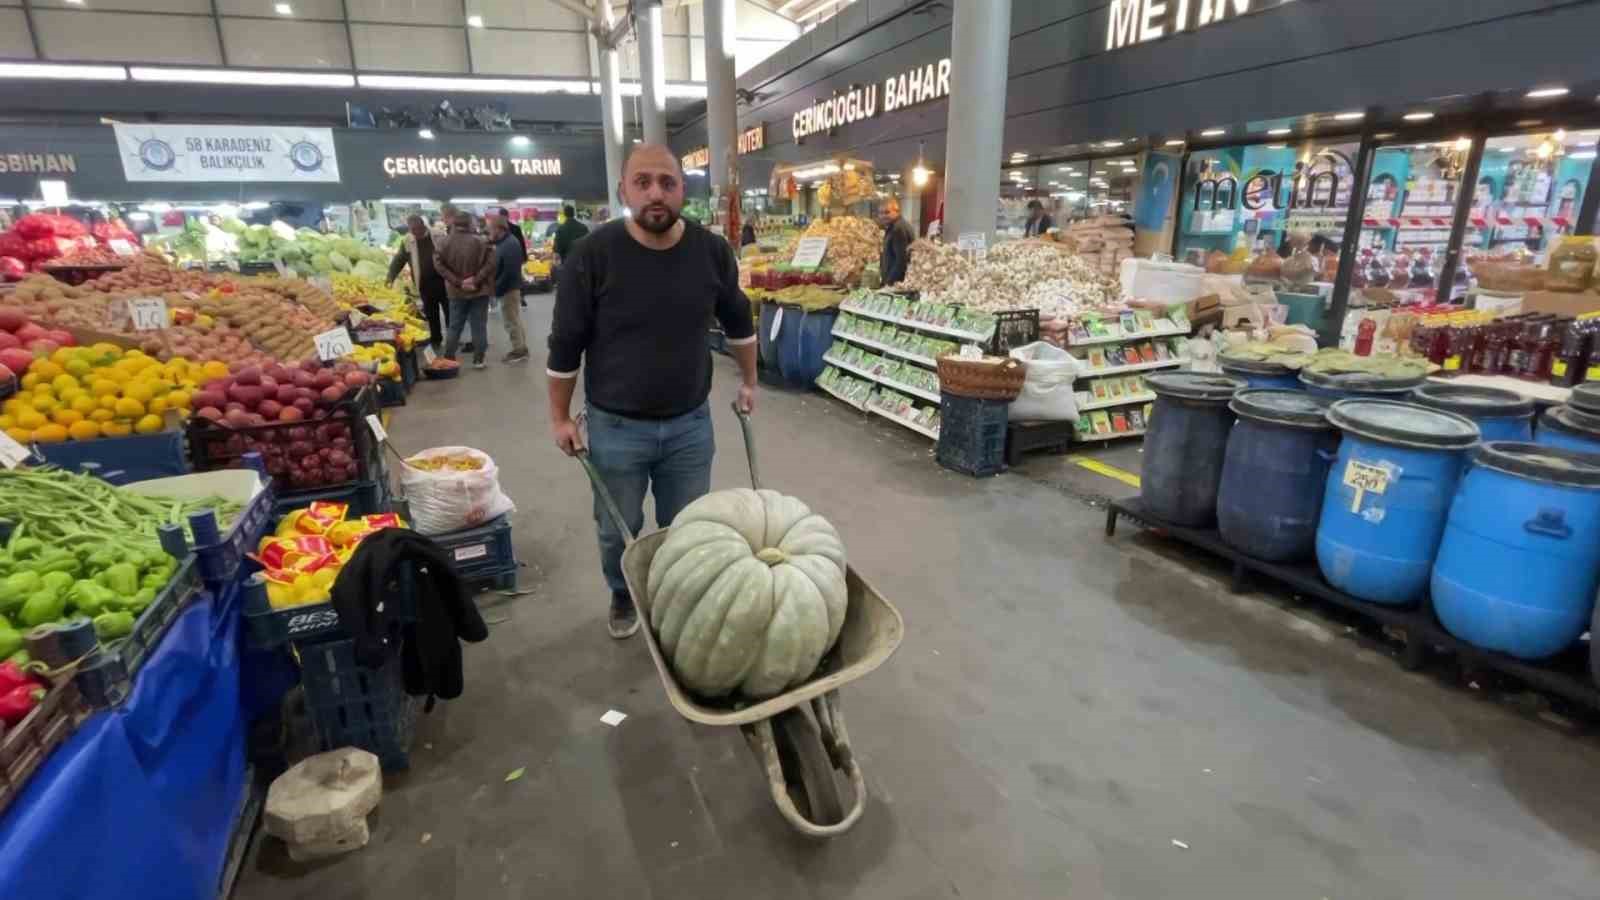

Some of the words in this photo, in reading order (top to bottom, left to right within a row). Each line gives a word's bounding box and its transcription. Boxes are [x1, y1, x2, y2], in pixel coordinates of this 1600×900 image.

[884, 58, 952, 112] BAHAR
[185, 137, 202, 152] 58
[205, 136, 272, 152] KARADENİZ
[200, 155, 265, 171] BALIKÇILIK
[384, 155, 503, 177] ÇERİKÇİOĞLU
[511, 159, 561, 175] TARIM
